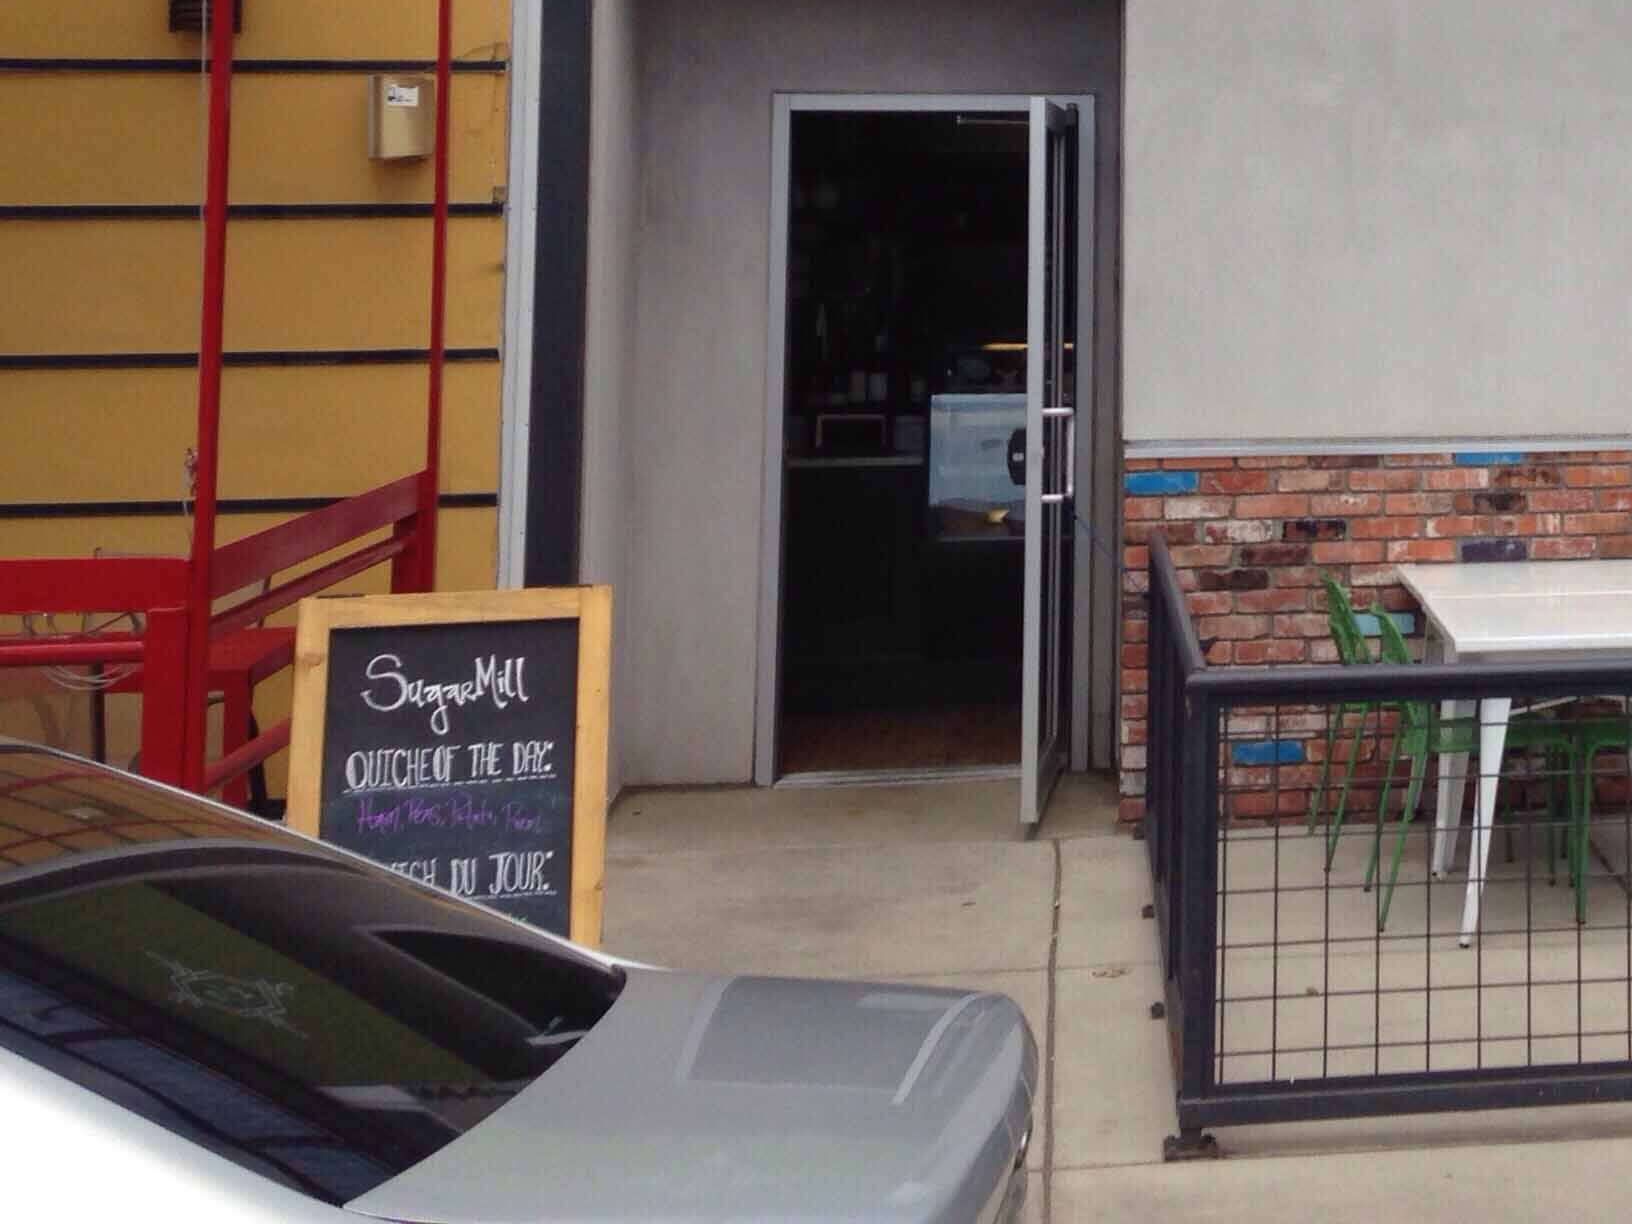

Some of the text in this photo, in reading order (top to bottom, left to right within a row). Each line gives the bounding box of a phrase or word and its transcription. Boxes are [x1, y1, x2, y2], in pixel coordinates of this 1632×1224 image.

[345, 748, 433, 790] QUICHE
[433, 744, 461, 782] OF
[467, 741, 504, 777] THE
[450, 857, 478, 897] DU
[489, 850, 554, 895] JOUR:
